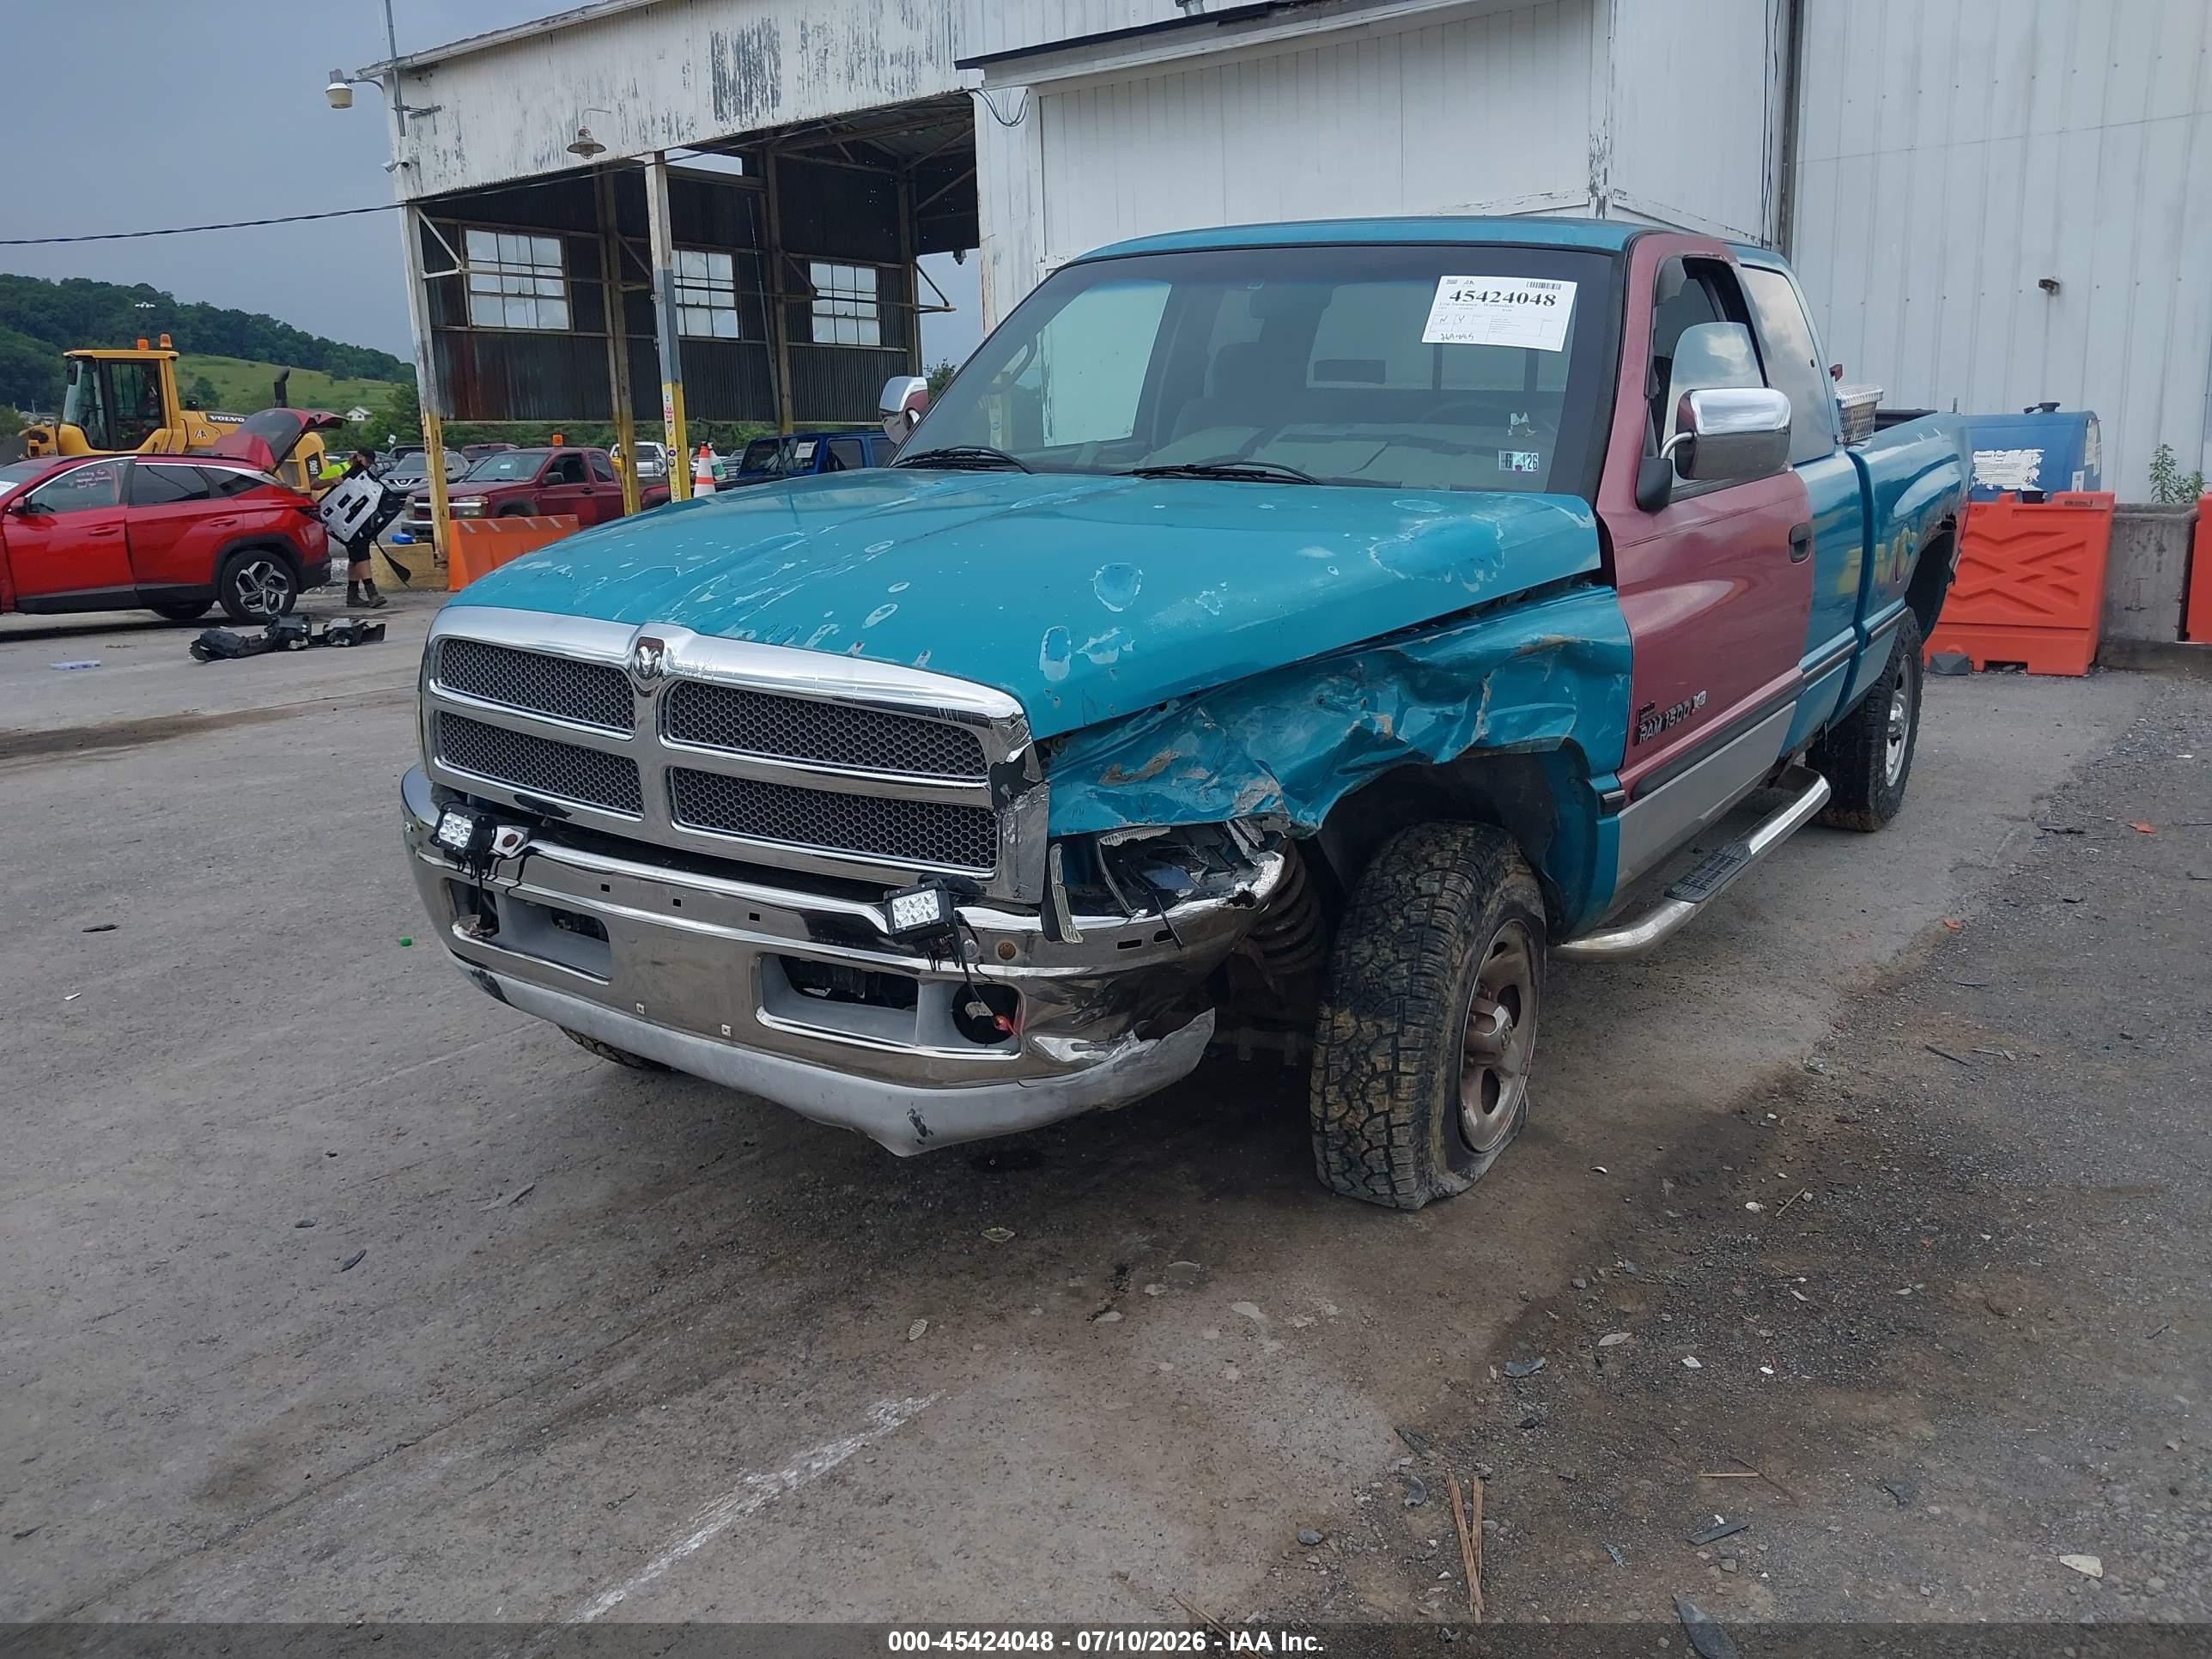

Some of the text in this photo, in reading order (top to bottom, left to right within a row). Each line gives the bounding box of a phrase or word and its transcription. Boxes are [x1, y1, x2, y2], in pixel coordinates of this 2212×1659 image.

[1449, 289, 1557, 307] 45424048
[1505, 453, 1538, 470] 6 26
[1638, 715, 1662, 744] RAM
[1665, 701, 1691, 729] 1500
